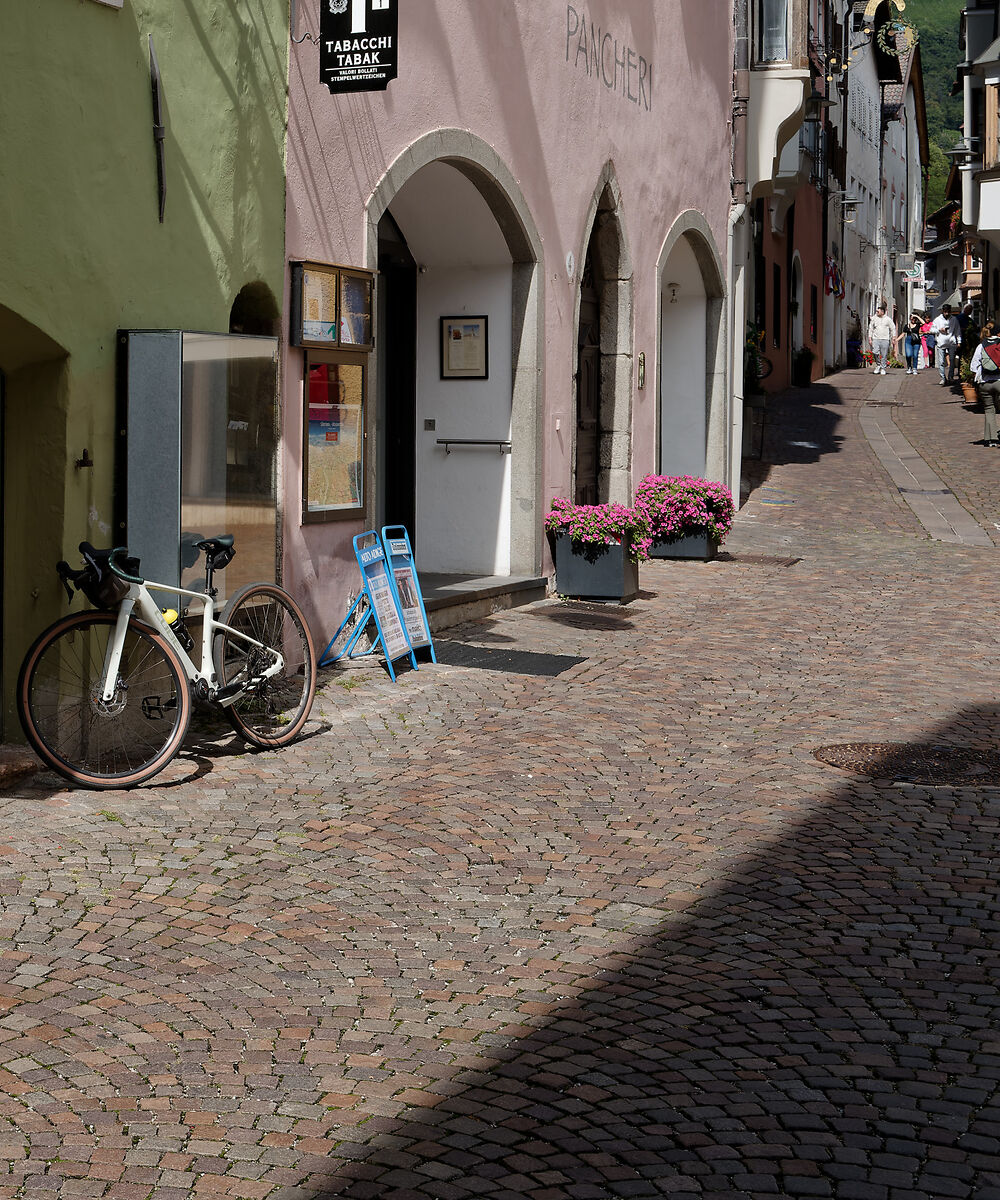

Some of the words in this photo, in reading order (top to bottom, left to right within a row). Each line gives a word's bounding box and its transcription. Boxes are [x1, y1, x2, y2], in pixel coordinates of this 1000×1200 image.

[325, 36, 392, 53] TABACCHI
[337, 52, 380, 67] TABAK
[566, 5, 652, 112] PANCHERI
[357, 67, 378, 75] BOLLATI
